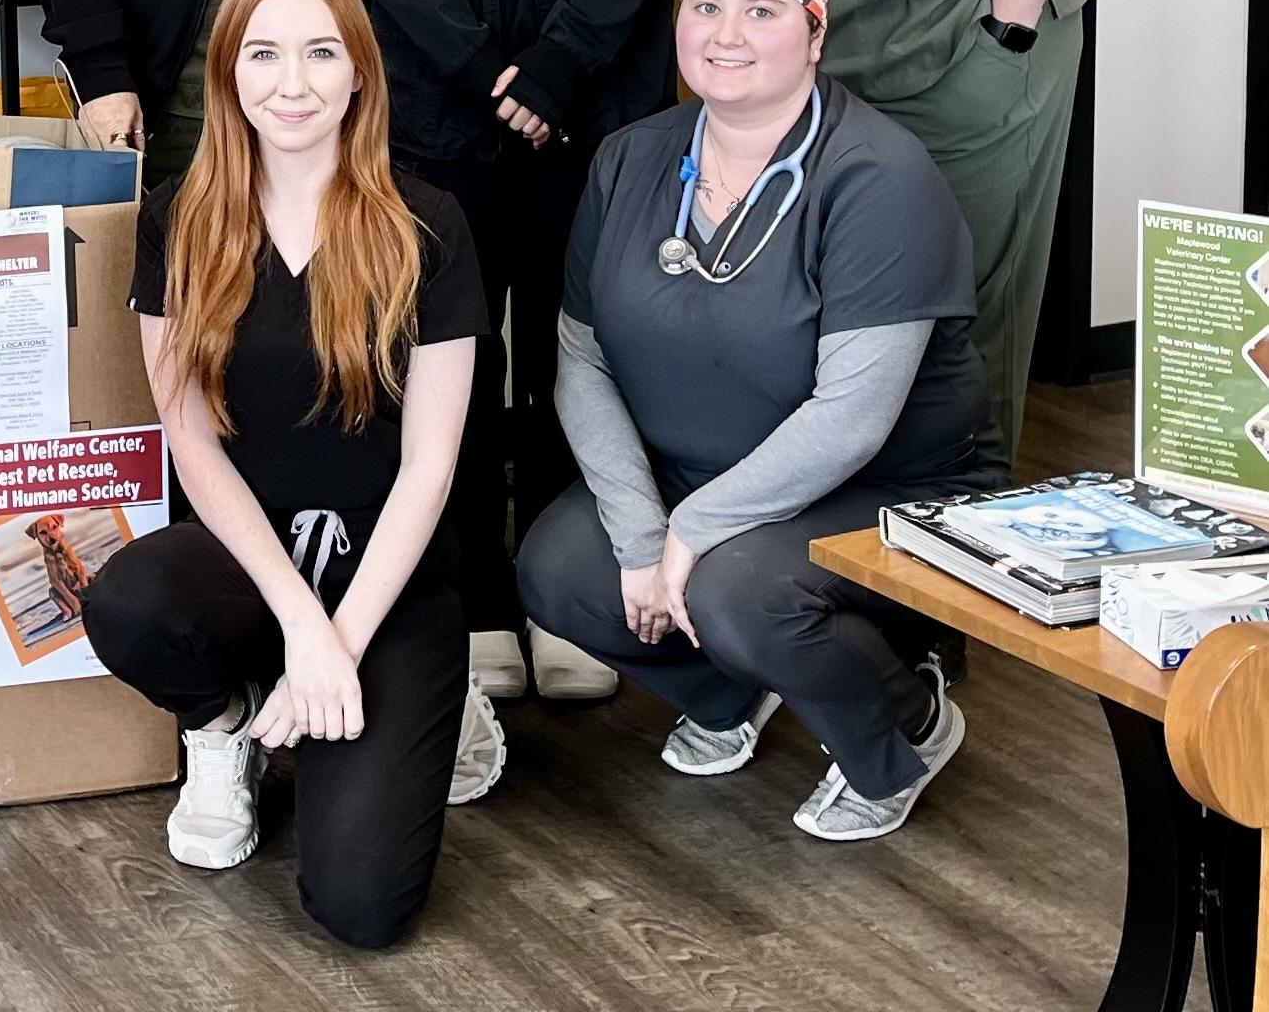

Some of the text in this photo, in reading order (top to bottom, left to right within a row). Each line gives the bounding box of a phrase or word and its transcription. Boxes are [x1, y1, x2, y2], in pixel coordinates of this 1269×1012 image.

[1145, 214, 1263, 243] WE'RE HIRING!
[1177, 236, 1220, 250] Maplewood
[1166, 247, 1231, 264] Veterinary Center
[2, 340, 47, 349] LOCATIONS
[1157, 335, 1172, 345] Who
[22, 438, 85, 462] Welfare
[89, 436, 146, 455] Center,
[28, 464, 55, 483] Pet
[58, 461, 118, 481] Rescue,
[12, 484, 79, 508] Humane
[81, 478, 141, 503] Society
